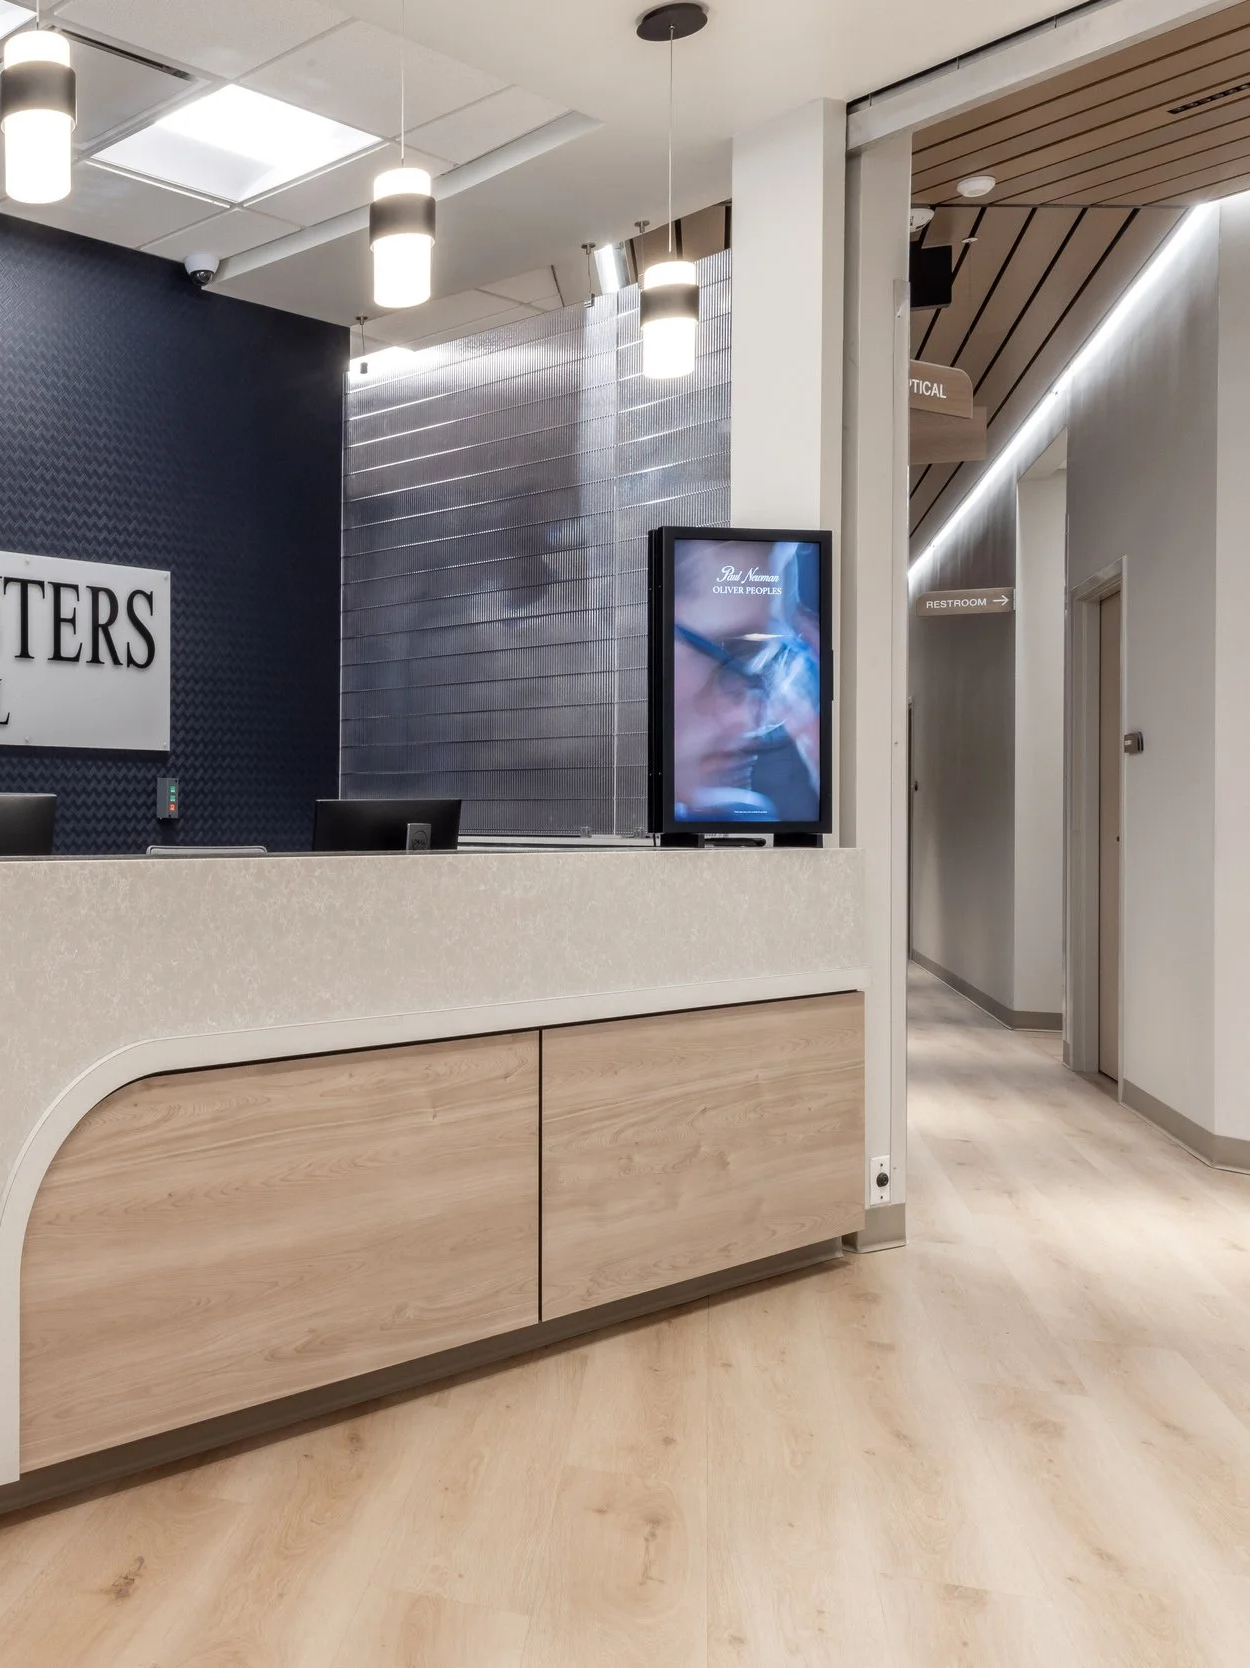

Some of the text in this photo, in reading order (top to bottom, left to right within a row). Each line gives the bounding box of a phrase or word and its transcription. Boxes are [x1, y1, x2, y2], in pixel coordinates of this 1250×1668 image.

[717, 565, 780, 584] Paul Newman
[712, 586, 783, 595] OLIVER PEOPLES
[926, 598, 987, 609] RESTROOM
